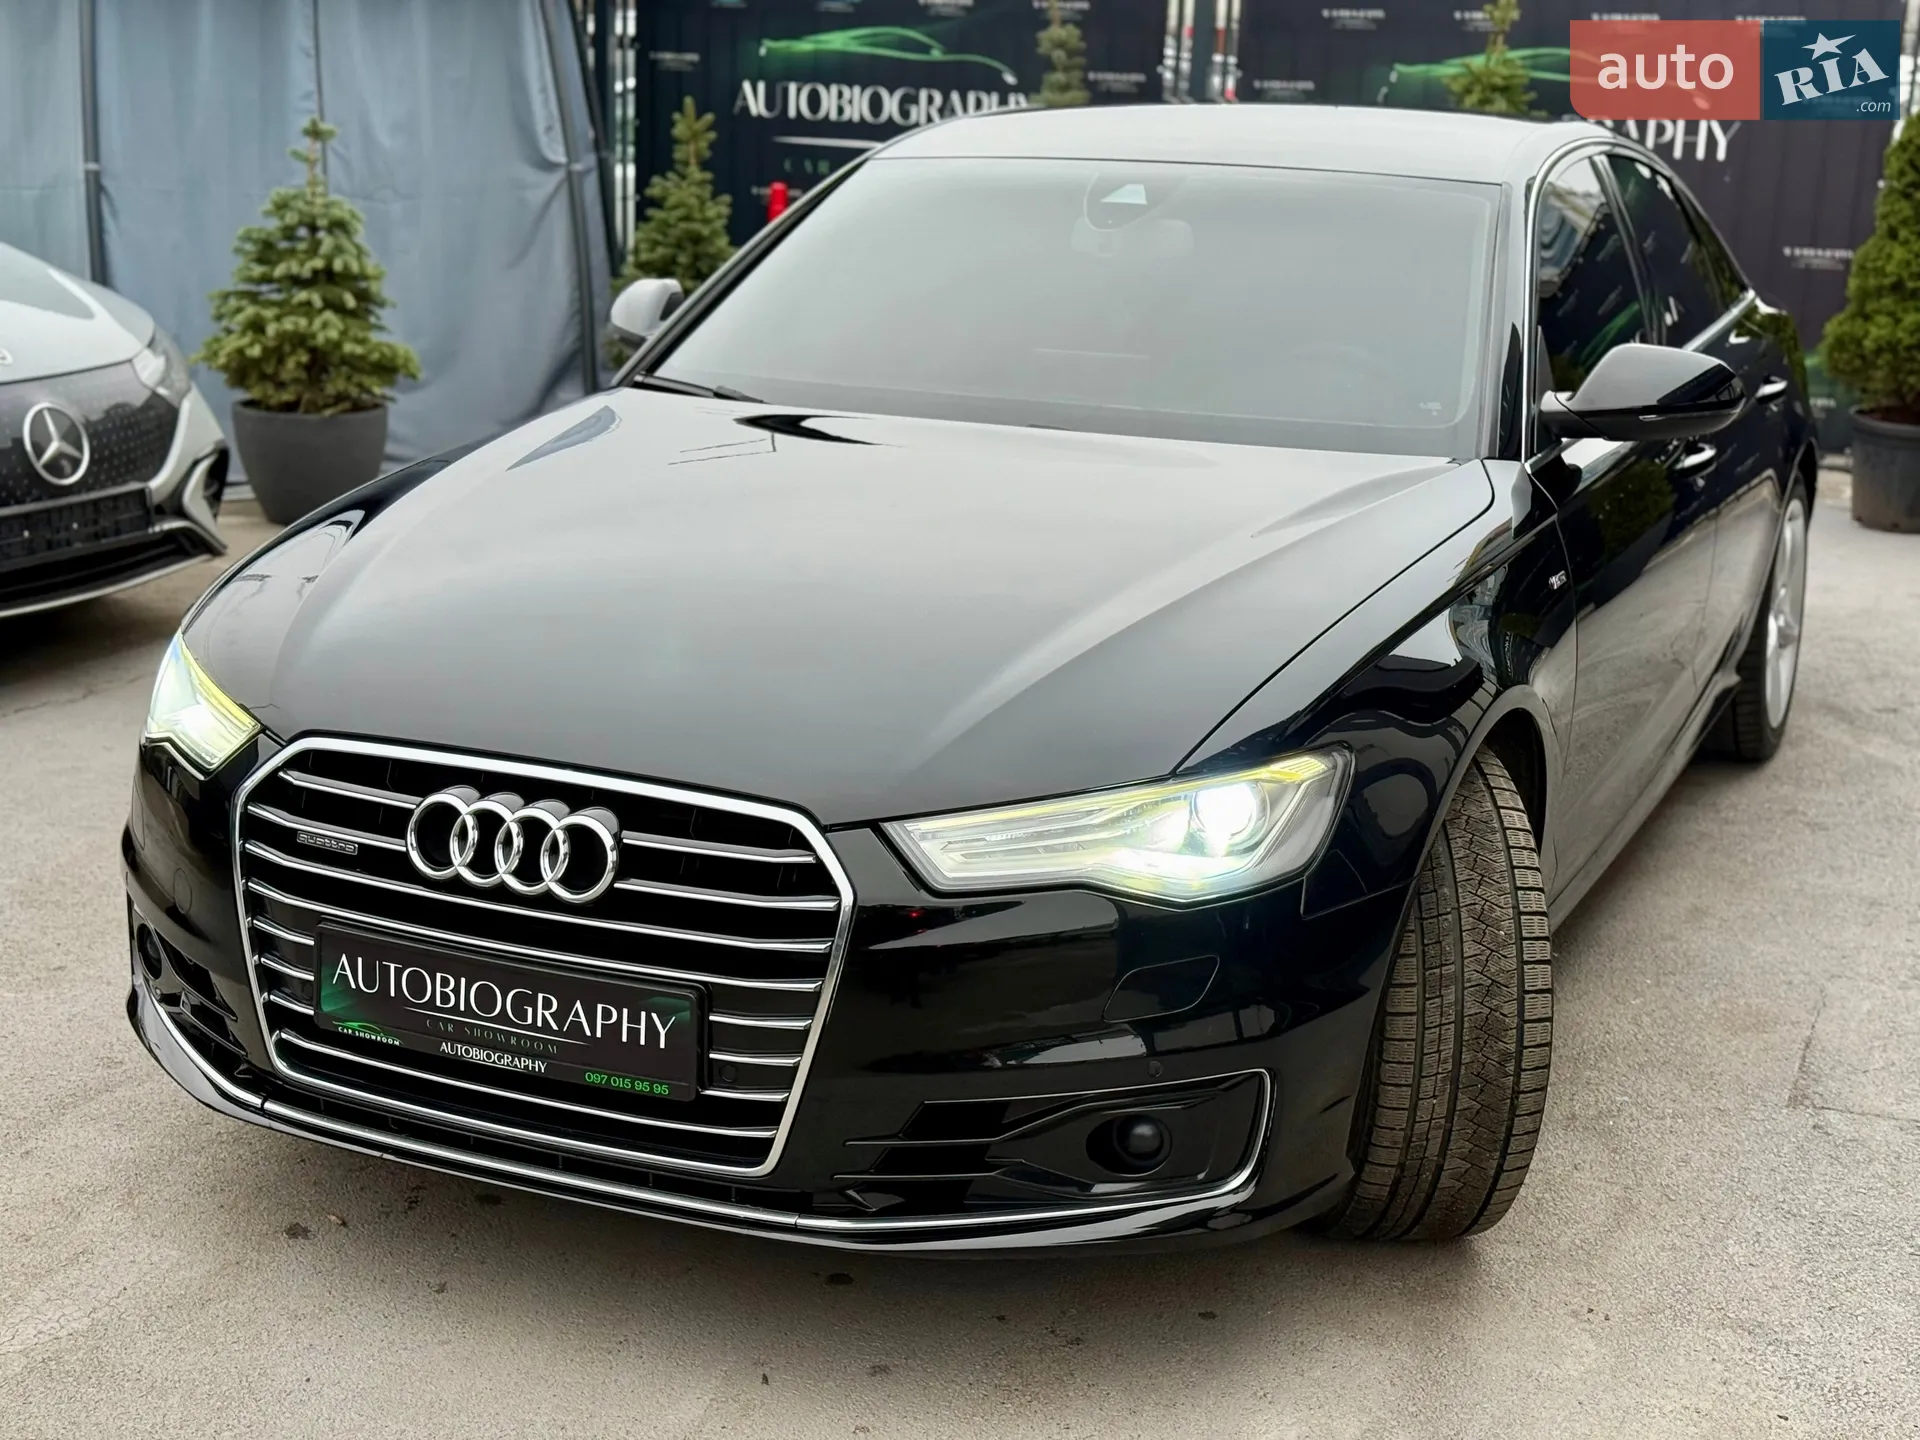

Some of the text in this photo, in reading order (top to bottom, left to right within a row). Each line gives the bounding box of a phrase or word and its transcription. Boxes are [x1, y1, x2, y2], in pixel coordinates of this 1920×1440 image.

[299, 833, 355, 852] quattro
[333, 953, 675, 1049] AUTOBIOGRAPHY
[338, 1026, 400, 1046] CAR SHOWROOM
[426, 1019, 558, 1054] CAR SHOWROOM
[440, 1041, 547, 1073] AUTOBIOGRAPHY
[585, 1072, 669, 1095] 097 015 95 95
